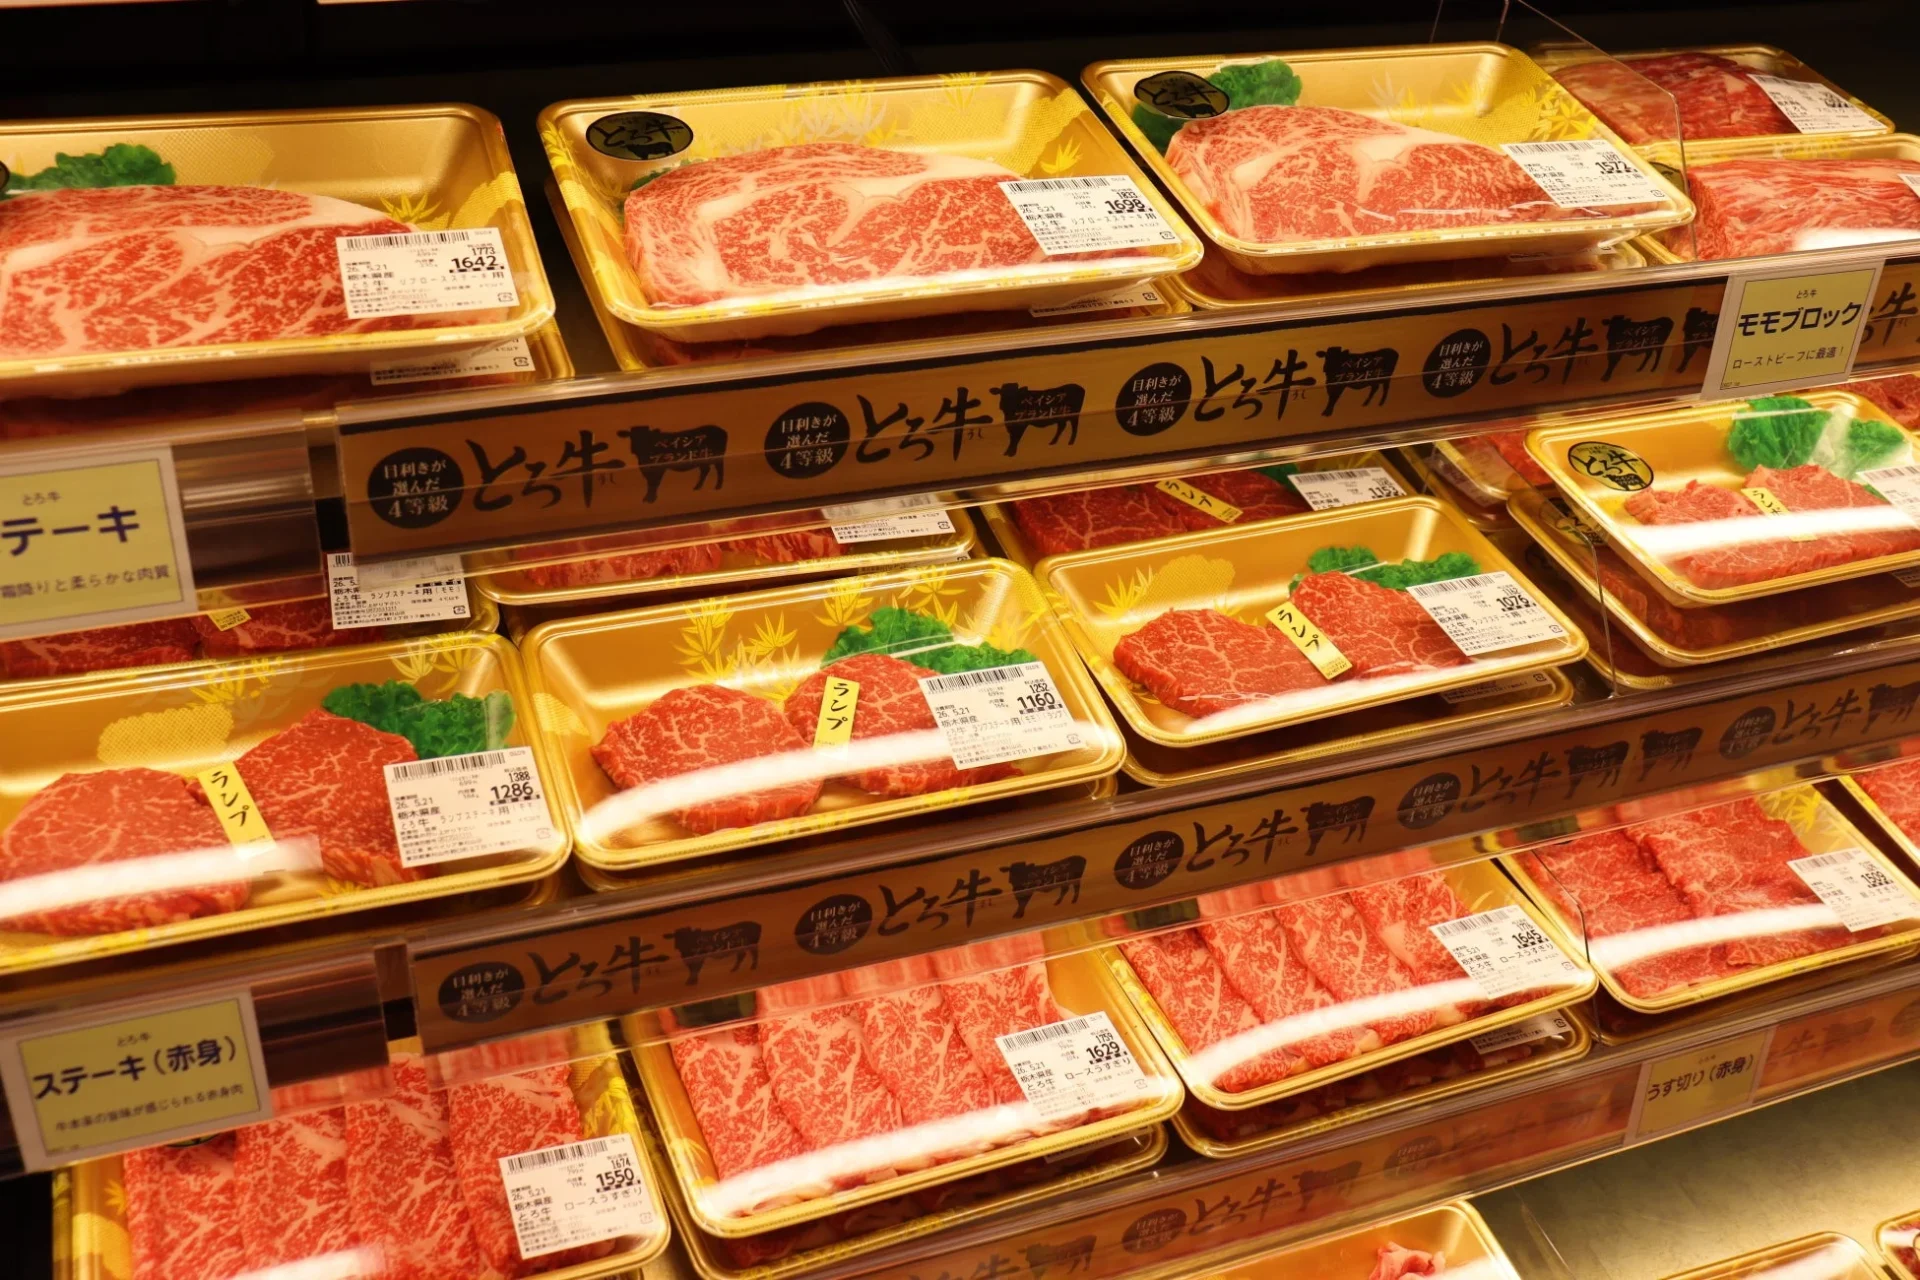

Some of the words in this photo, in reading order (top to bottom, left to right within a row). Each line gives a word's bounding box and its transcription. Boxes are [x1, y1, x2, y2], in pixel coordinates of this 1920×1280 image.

[1595, 161, 1631, 171] 1572
[1105, 198, 1146, 211] 1698
[472, 246, 496, 256] 1773
[450, 254, 500, 269] 1642
[1796, 289, 1818, 299] とろ牛
[1738, 301, 1863, 337] モモブロック
[1439, 340, 1484, 357] 目利きが
[1488, 317, 1601, 387] とろ牛
[1732, 345, 1845, 370] ローストビーフに最適！
[1440, 355, 1473, 372] 選んだ
[1132, 374, 1182, 392] 目利きが
[1194, 349, 1318, 422] とろ牛
[1431, 370, 1474, 390] 4等級
[1134, 389, 1173, 407] 選んだ
[781, 414, 838, 435] 目利きが
[855, 387, 994, 463] とろ牛
[1127, 406, 1175, 428] 4等級
[786, 431, 830, 448] 選んだ
[780, 447, 834, 470] 4等級
[1570, 449, 1640, 476] とろ牛
[383, 459, 448, 480] 目利きが
[464, 429, 627, 512] とろ牛
[391, 478, 441, 497] 選んだ
[22, 490, 61, 507] とろ牛
[388, 495, 449, 519] 4等級
[0, 505, 140, 557] テーキ
[1495, 595, 1531, 606] 1076
[1277, 609, 1319, 652] ランプ
[1030, 682, 1051, 694] 1252
[825, 682, 850, 731] ランプ
[1016, 692, 1056, 710] 1160
[936, 710, 951, 719] 26.
[953, 706, 971, 717] 5.21
[940, 715, 978, 728] 栃木県産
[507, 770, 532, 783] 1388
[210, 770, 250, 827] ランプ
[489, 781, 535, 800] 1286
[395, 800, 408, 811] 26.
[414, 796, 434, 807] 5.21
[397, 806, 441, 821] 栃木県産
[1129, 838, 1175, 858] 目利きが
[1186, 808, 1299, 873] とろ牛
[810, 901, 862, 922] 目利きが
[876, 868, 1004, 937] とろ牛
[814, 916, 853, 934] 選んだ
[811, 927, 859, 950] 4等級
[1511, 929, 1542, 945] 1645
[1468, 960, 1492, 972] とろ牛
[1499, 943, 1554, 963] ロースうすぎり
[453, 966, 509, 989] 目利きが
[526, 936, 671, 1004] とろ牛
[1095, 1031, 1115, 1044] 1759
[1085, 1040, 1121, 1059] 1629
[32, 1035, 237, 1101] ステーキ（赤身）
[1014, 1066, 1026, 1074] 26.
[1029, 1061, 1046, 1071] 5.21
[1020, 1068, 1054, 1083] 栃木県産
[1026, 1078, 1056, 1092] とろ牛
[1064, 1057, 1132, 1081] ロースうすぎり
[1647, 1053, 1755, 1102] うす切り（赤身）
[610, 1157, 632, 1170] 1674
[595, 1167, 635, 1187] 1550
[512, 1191, 523, 1201] 26.
[528, 1186, 547, 1198] 5.21
[518, 1207, 552, 1221] とろ牛
[563, 1187, 643, 1212] ロースうすぎり
[1188, 1177, 1293, 1237] とろ牛
